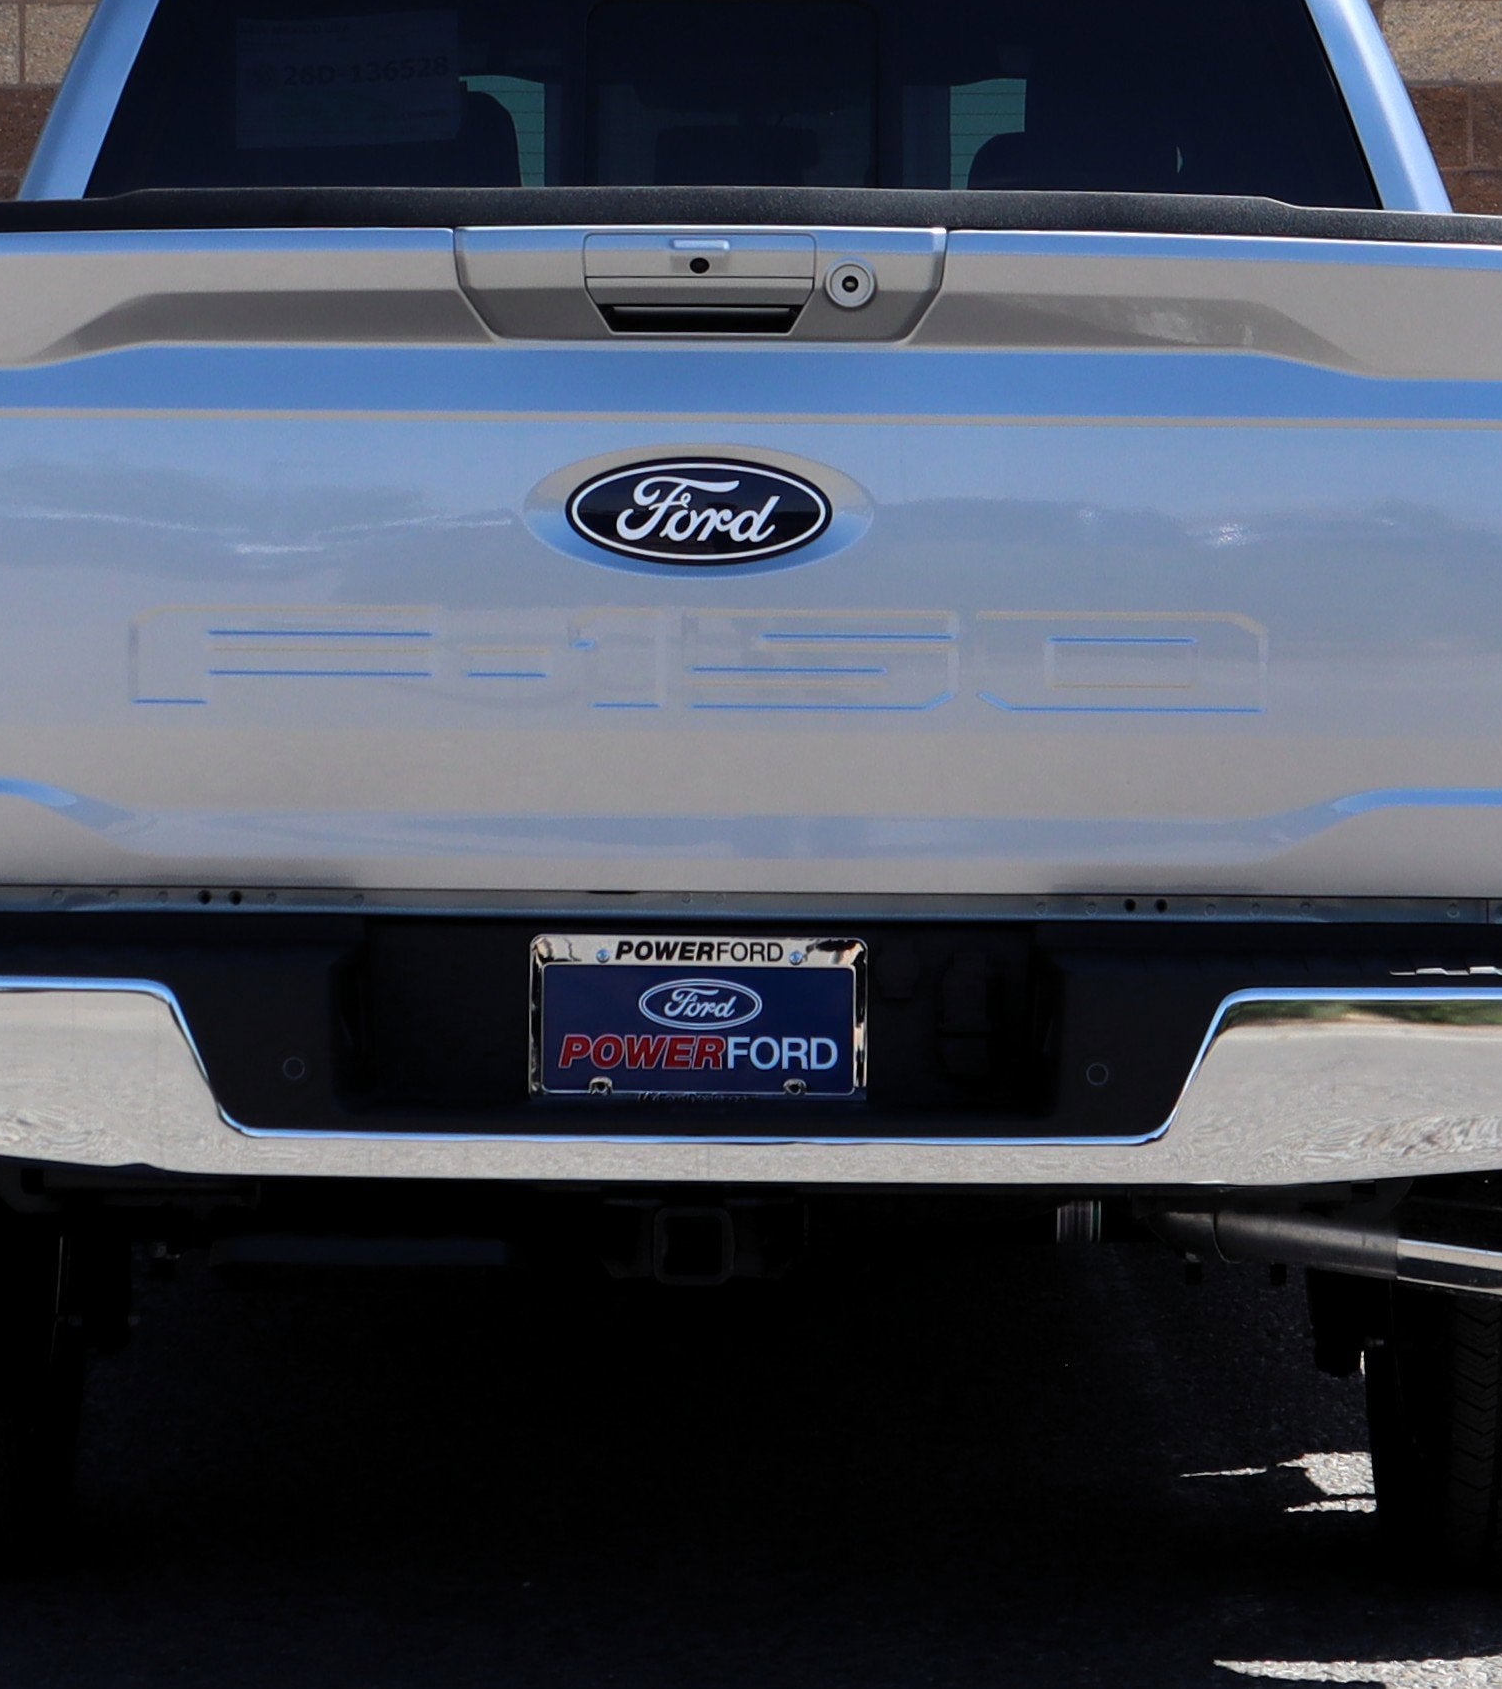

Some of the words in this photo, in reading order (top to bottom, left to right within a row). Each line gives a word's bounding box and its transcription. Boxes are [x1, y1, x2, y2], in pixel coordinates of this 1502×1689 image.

[615, 476, 781, 542] Ford
[130, 605, 1268, 713] F-150
[615, 940, 784, 963] POWERFORD
[663, 987, 737, 1018] Ford
[558, 1033, 839, 1071] POWERFORD
